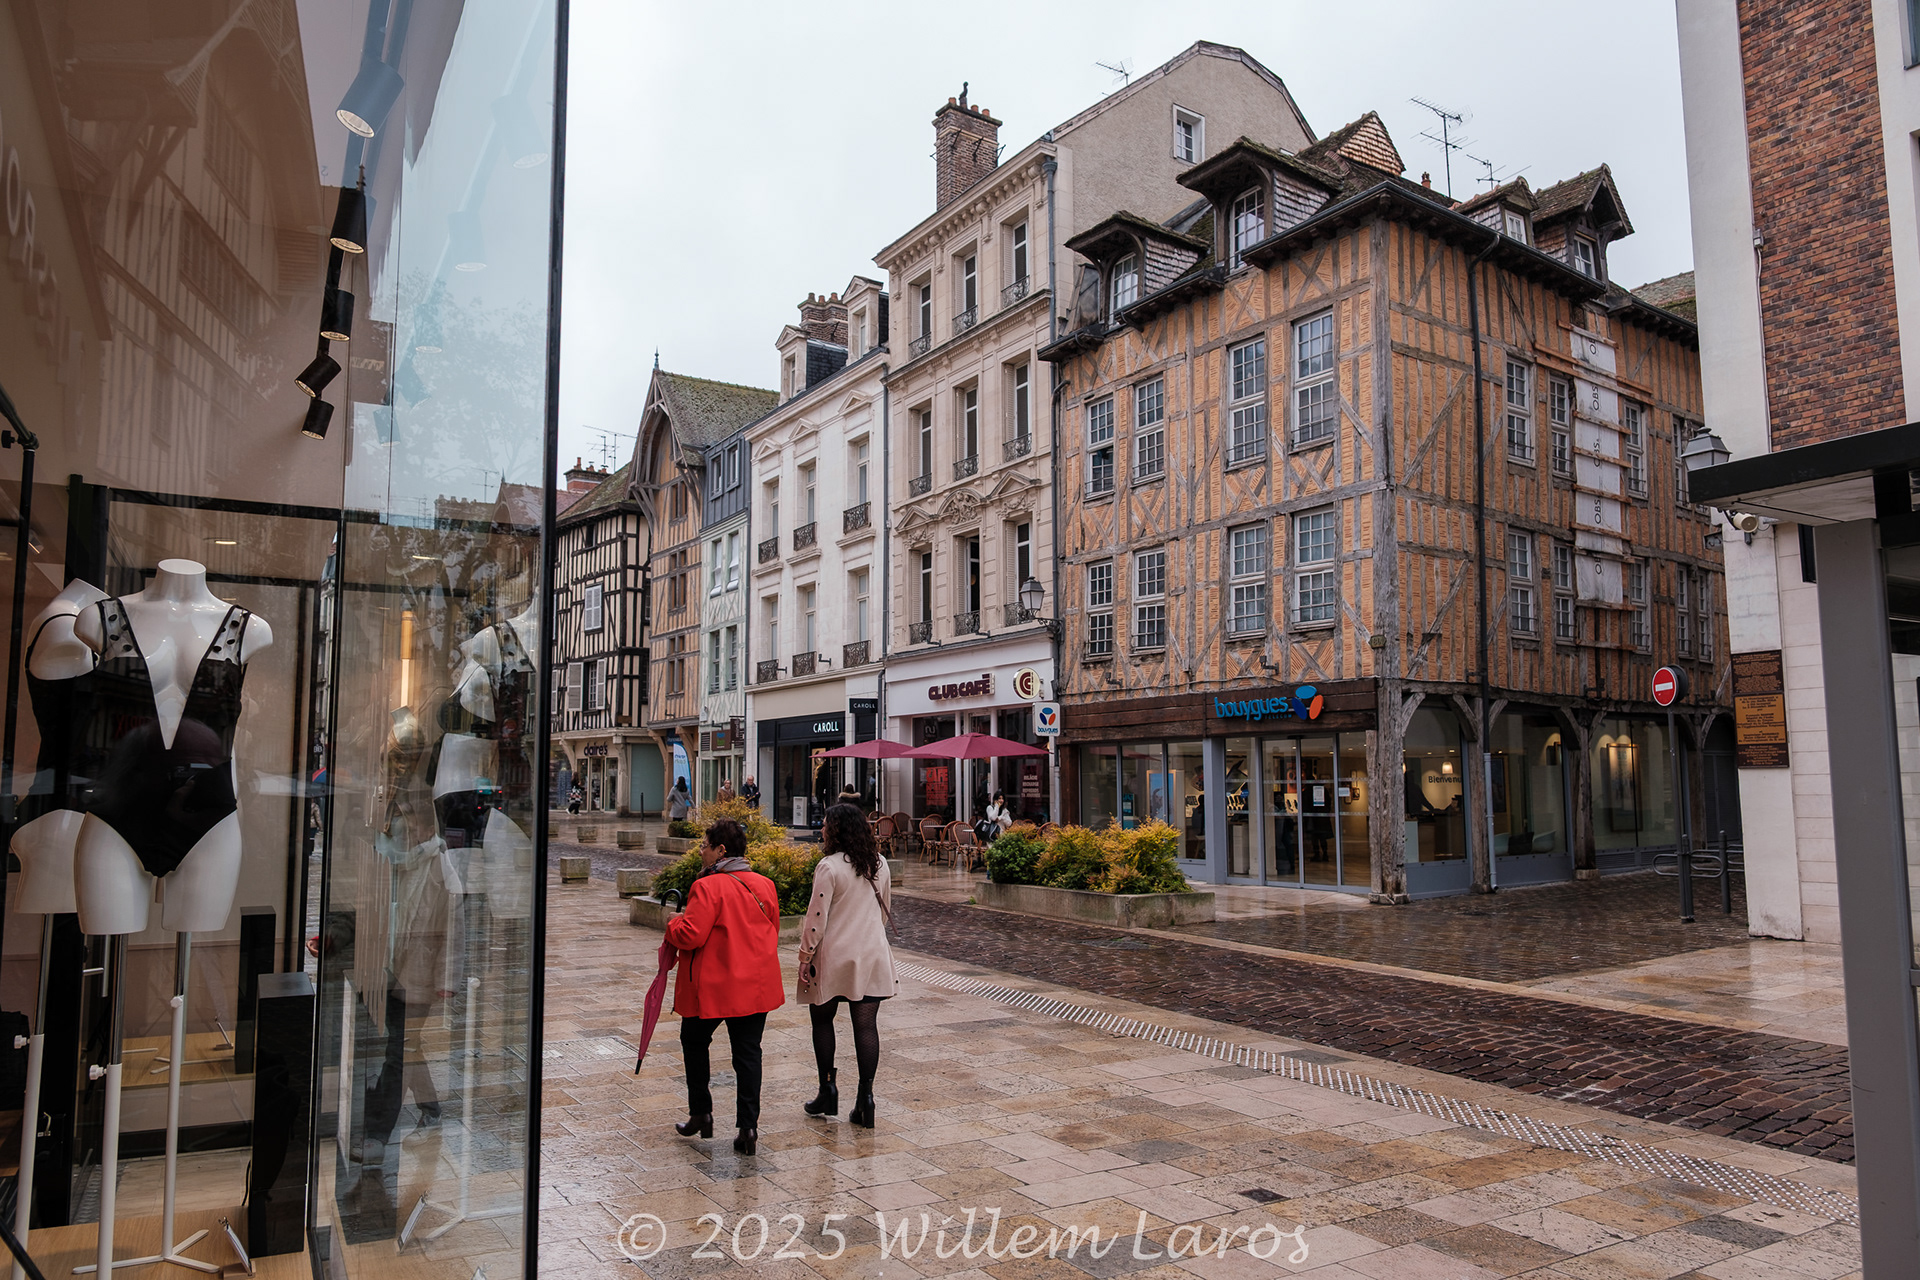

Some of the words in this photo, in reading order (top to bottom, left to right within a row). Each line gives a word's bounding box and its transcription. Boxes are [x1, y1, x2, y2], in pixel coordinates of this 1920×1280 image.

[928, 683, 958, 701] CLUB
[1214, 696, 1289, 721] bouygues
[813, 721, 839, 733] CAROLL
[1037, 726, 1059, 734] bouygues
